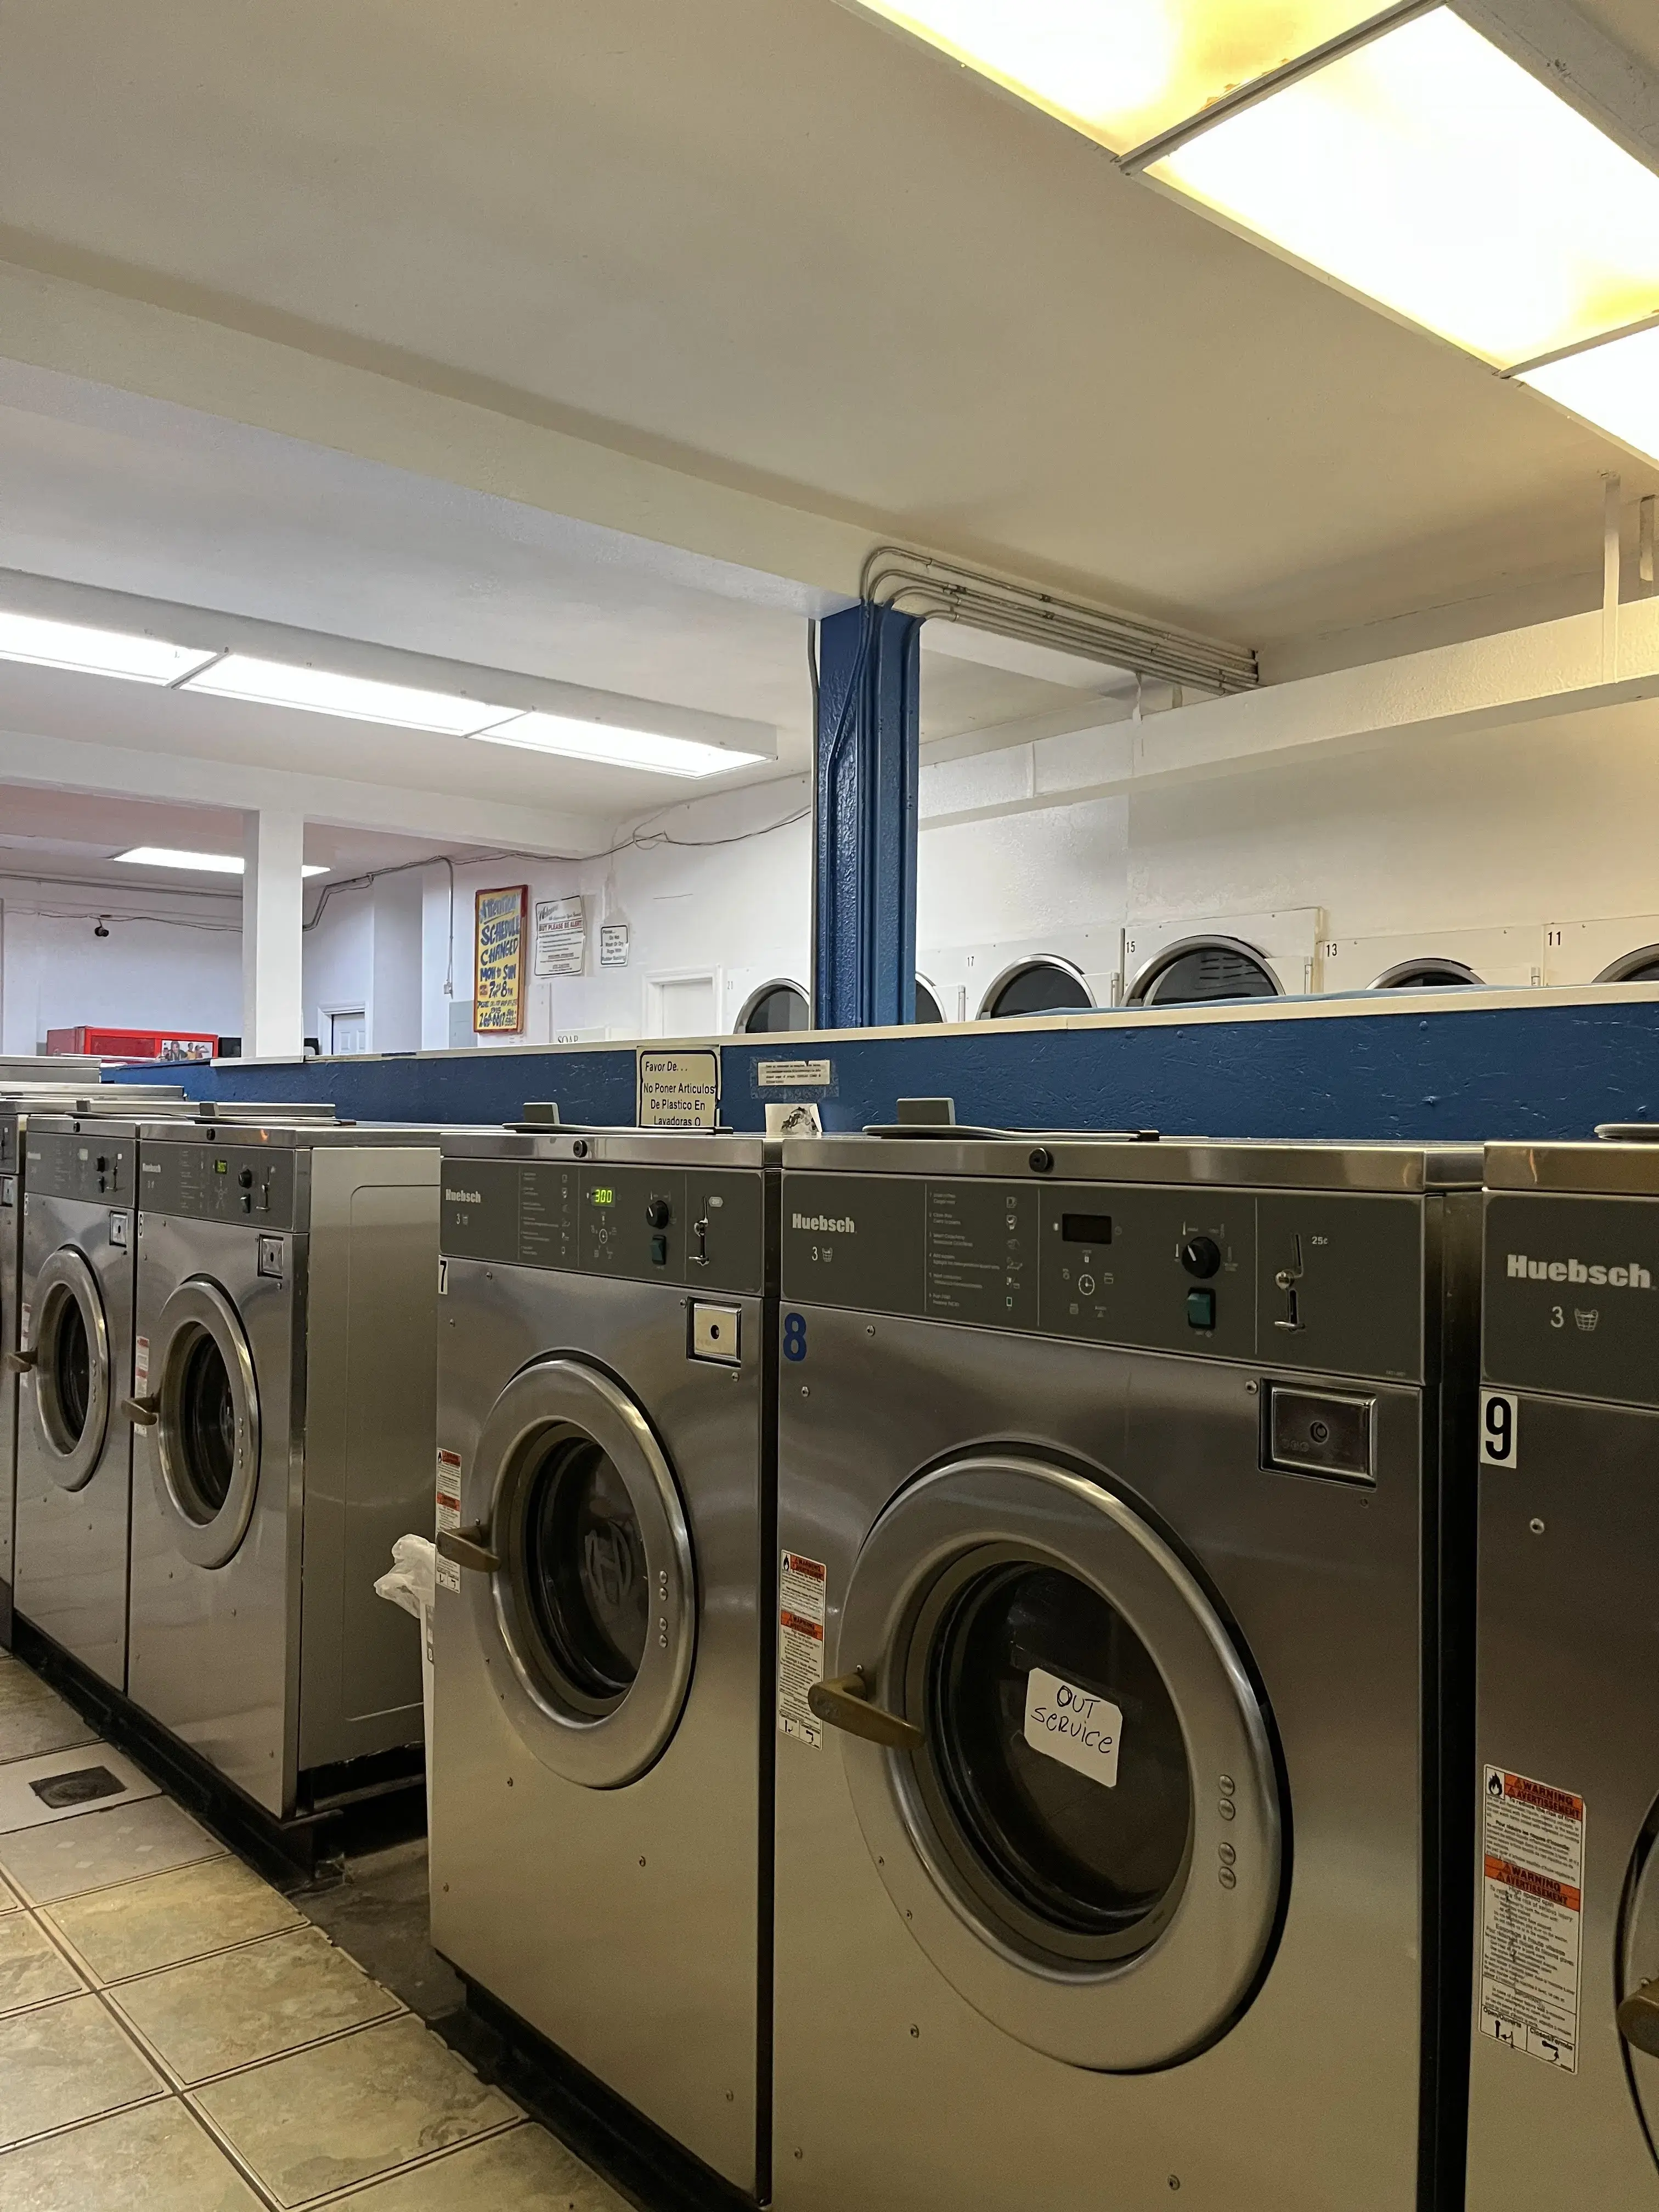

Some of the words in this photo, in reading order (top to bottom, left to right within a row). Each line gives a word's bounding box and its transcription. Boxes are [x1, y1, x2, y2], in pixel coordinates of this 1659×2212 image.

[1126, 941, 1135, 953] 15
[1548, 932, 1561, 946] 11
[481, 938, 518, 966] CHANGED
[1326, 944, 1338, 957] 13
[968, 956, 974, 967] 17
[727, 981, 733, 990] 21
[645, 1062, 665, 1071] Favor
[644, 1083, 653, 1093] No
[655, 1083, 676, 1093] Poner
[678, 1083, 715, 1094] Articulos
[651, 1099, 659, 1109] De
[662, 1099, 692, 1110] Plastico
[695, 1100, 706, 1110] En
[654, 1116, 692, 1126] Lavadoras
[445, 1189, 481, 1203] Huebsch
[595, 1189, 613, 1203] 300
[792, 1213, 855, 1233] Huebsch
[811, 1246, 818, 1261] 3
[440, 1260, 447, 1292] 7
[1507, 1254, 1651, 1288] Huebsch
[1551, 1306, 1564, 1328] 3
[783, 1312, 807, 1362] 8
[1486, 1397, 1511, 1460] 9
[1057, 1685, 1101, 1718] OUT
[1523, 1780, 1573, 1806] WARNING
[1517, 1790, 1579, 1819] AVERTISSEMENT
[1511, 1866, 1561, 1893] WARNING
[1505, 1874, 1568, 1904] AVERTISSEMENT
